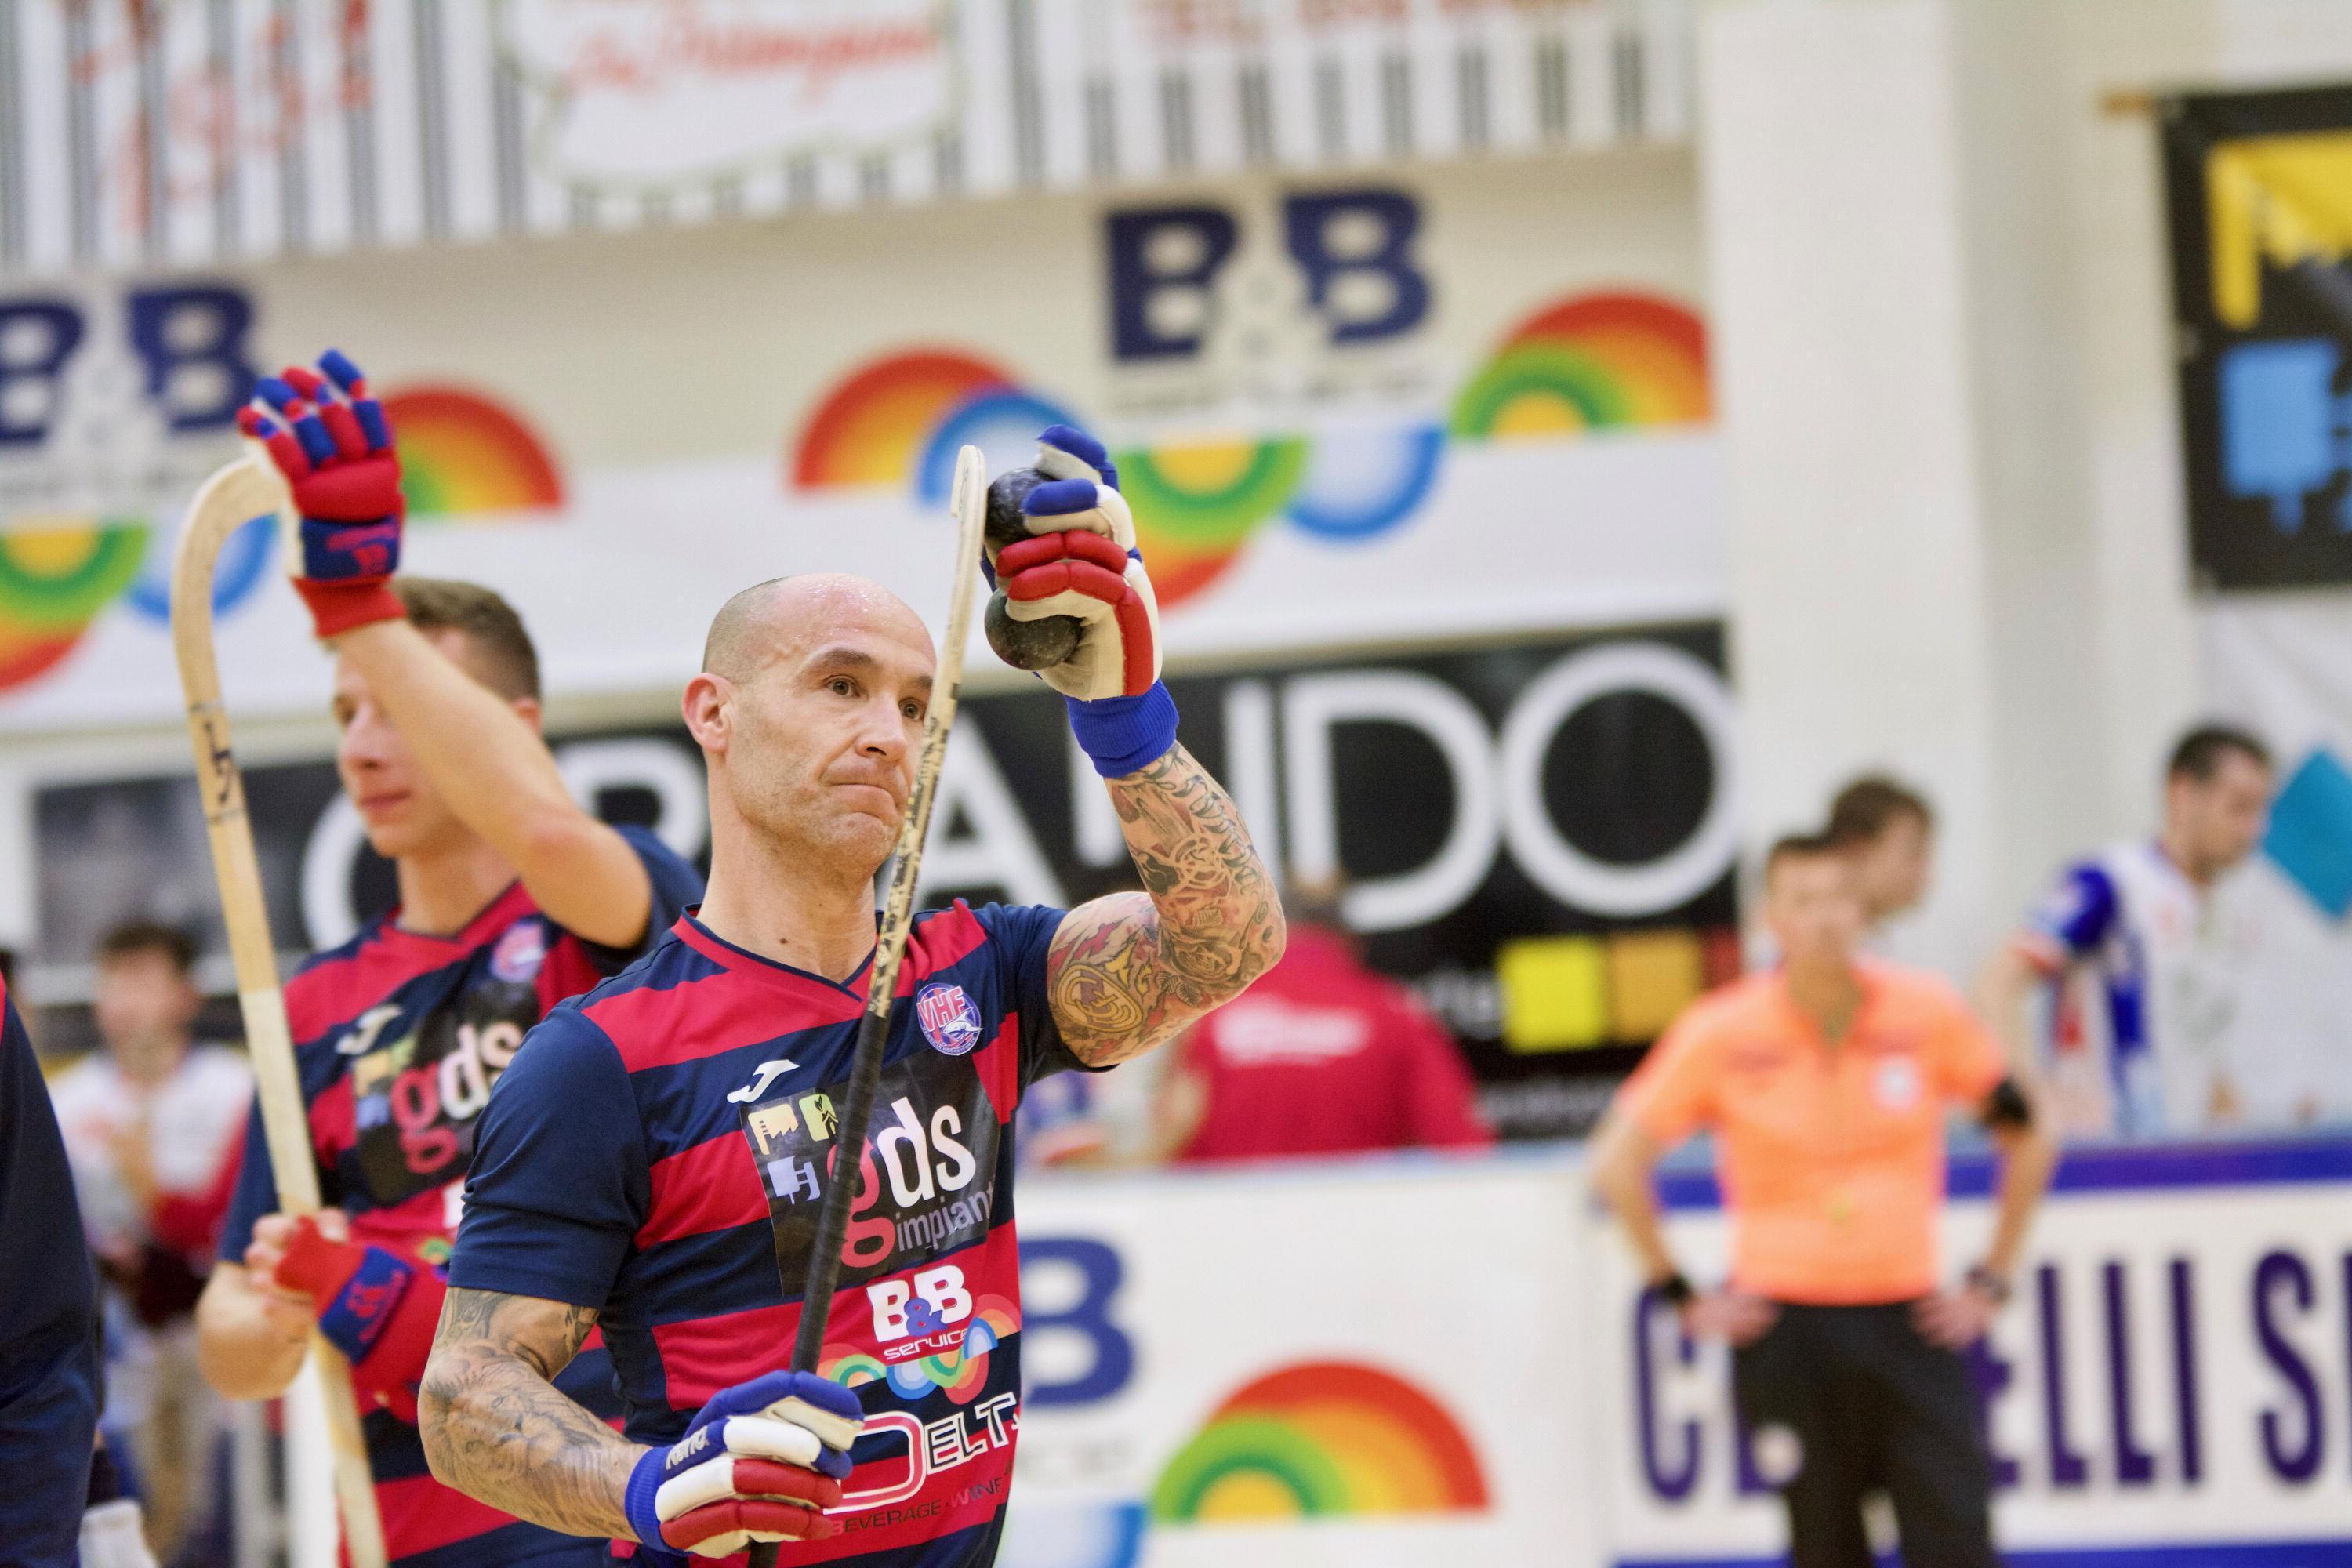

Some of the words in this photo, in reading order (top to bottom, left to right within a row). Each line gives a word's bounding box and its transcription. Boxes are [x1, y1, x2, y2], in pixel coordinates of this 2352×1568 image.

[916, 985, 964, 1032] VHF
[827, 1097, 976, 1269] gds
[866, 1265, 973, 1342] B&B
[823, 1391, 1019, 1515] DELT
